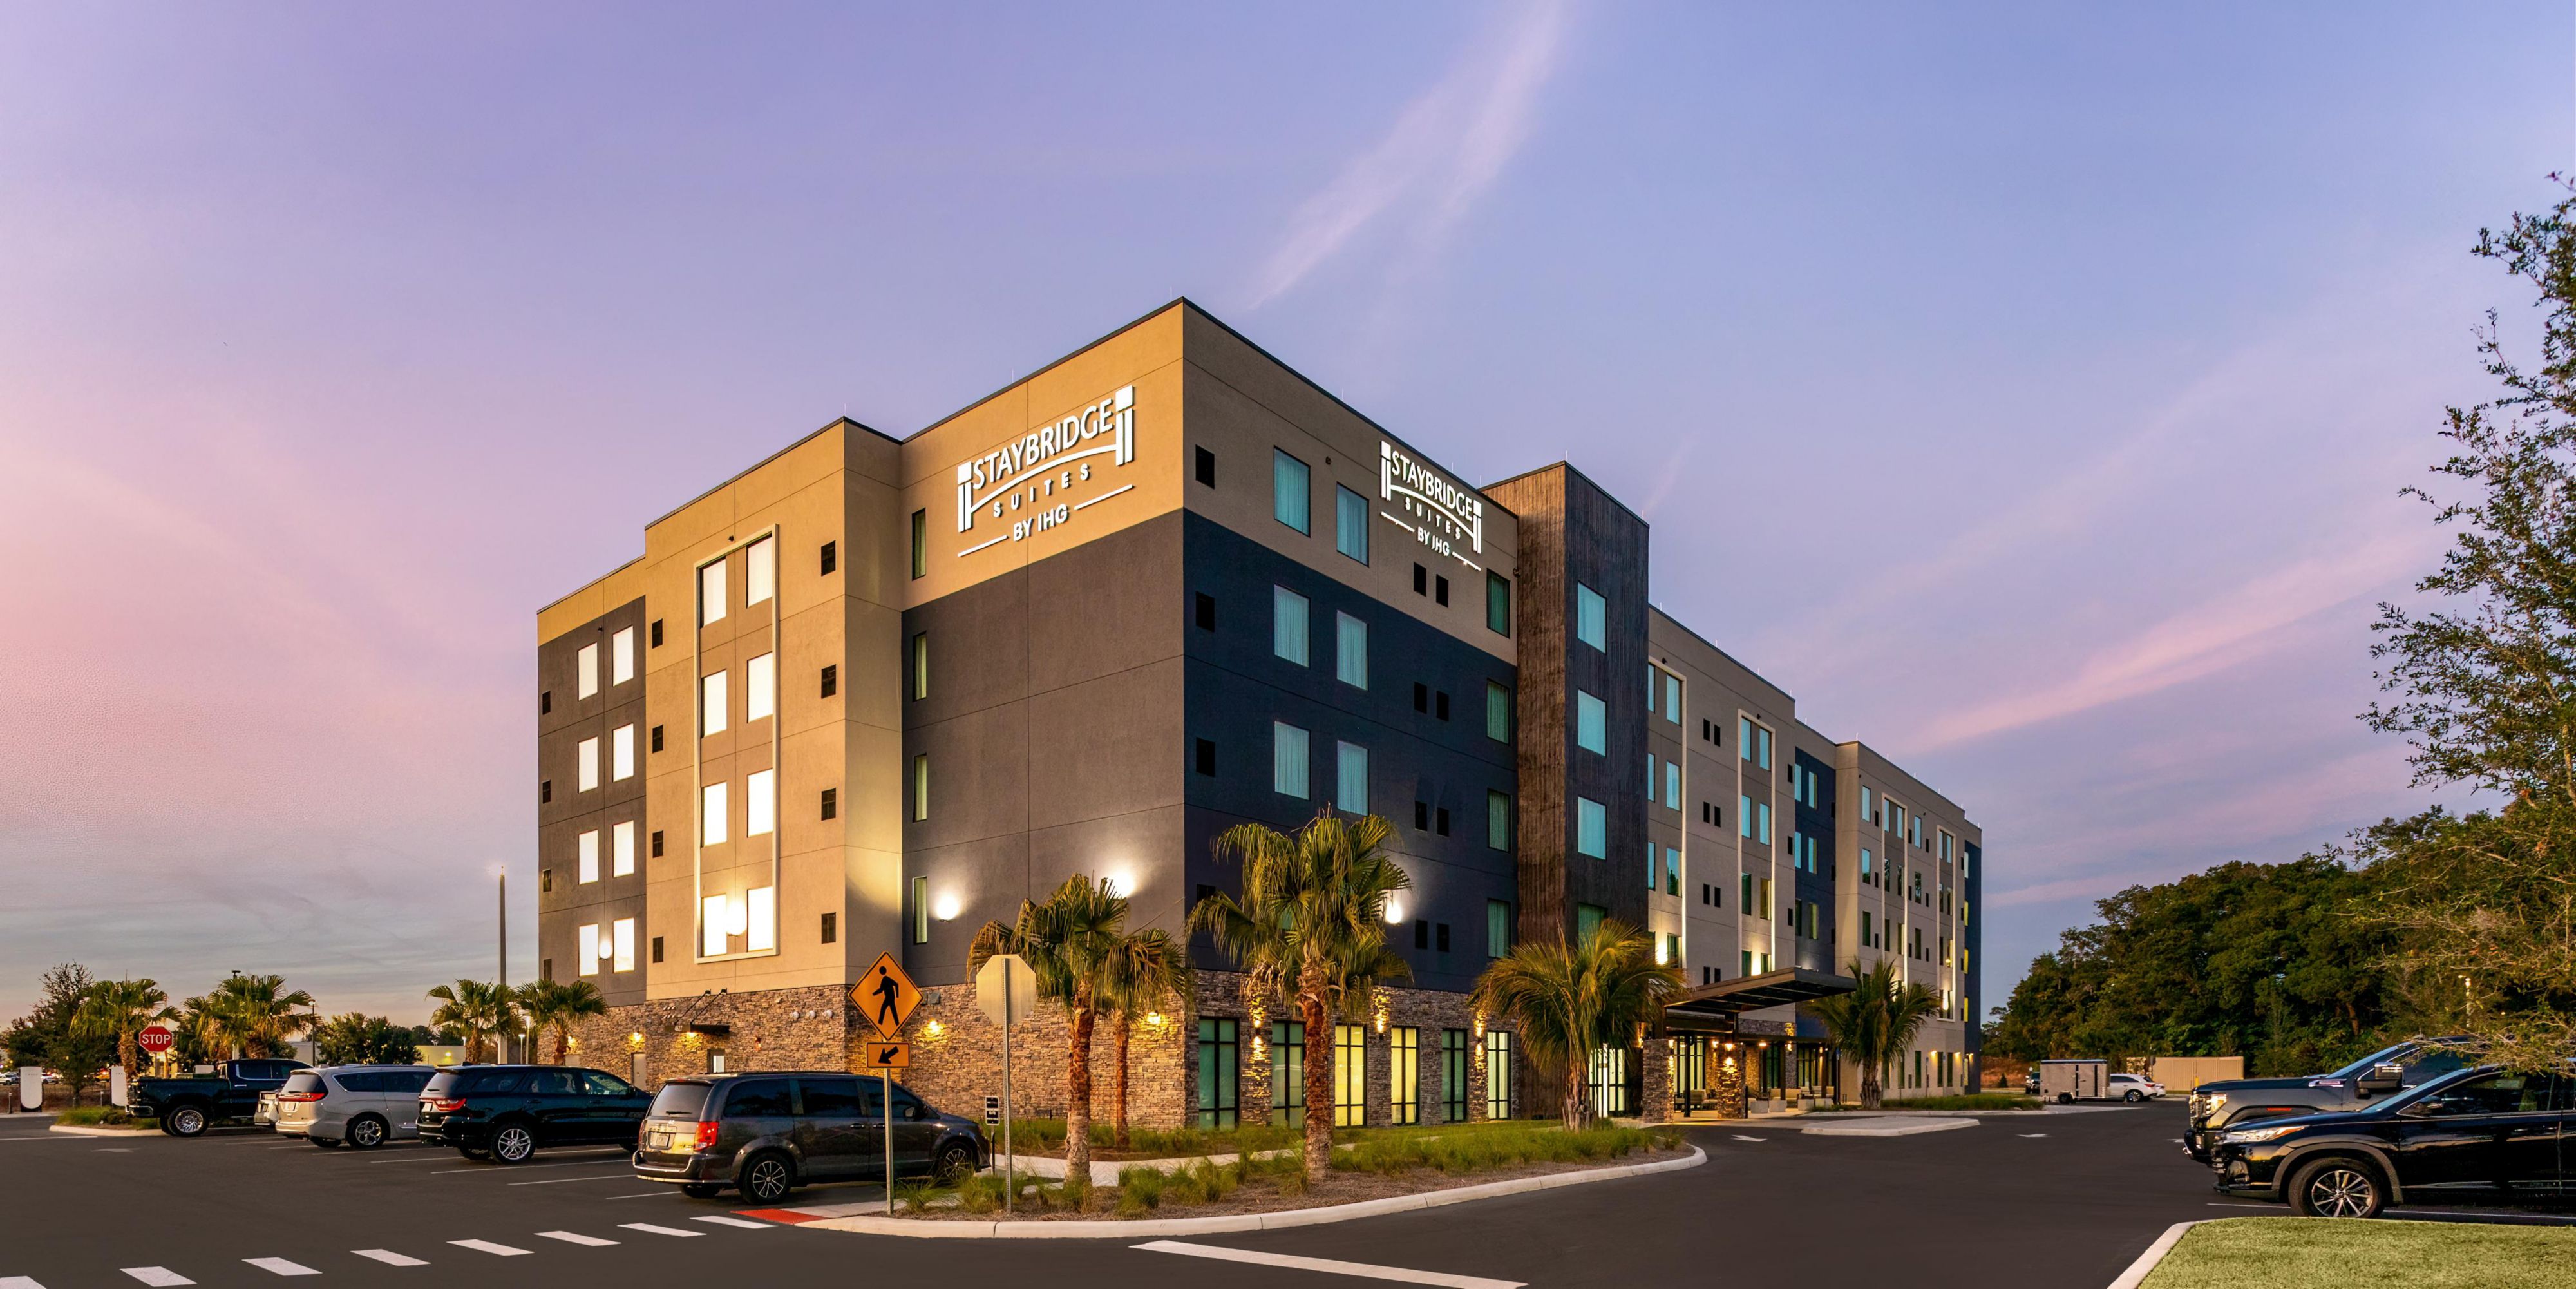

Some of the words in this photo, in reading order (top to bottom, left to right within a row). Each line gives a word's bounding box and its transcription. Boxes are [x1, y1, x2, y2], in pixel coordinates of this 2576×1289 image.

[972, 397, 1113, 490] STAYBRIDGE
[993, 463, 1090, 518] SUITES
[1391, 450, 1473, 522] STAYBRIDGE
[1013, 517, 1034, 542] BY
[1037, 503, 1068, 531] IHG
[1405, 497, 1461, 540] SUITES
[1417, 526, 1430, 546] BY
[1431, 535, 1450, 557] IHG
[142, 1033, 171, 1044] STOP
